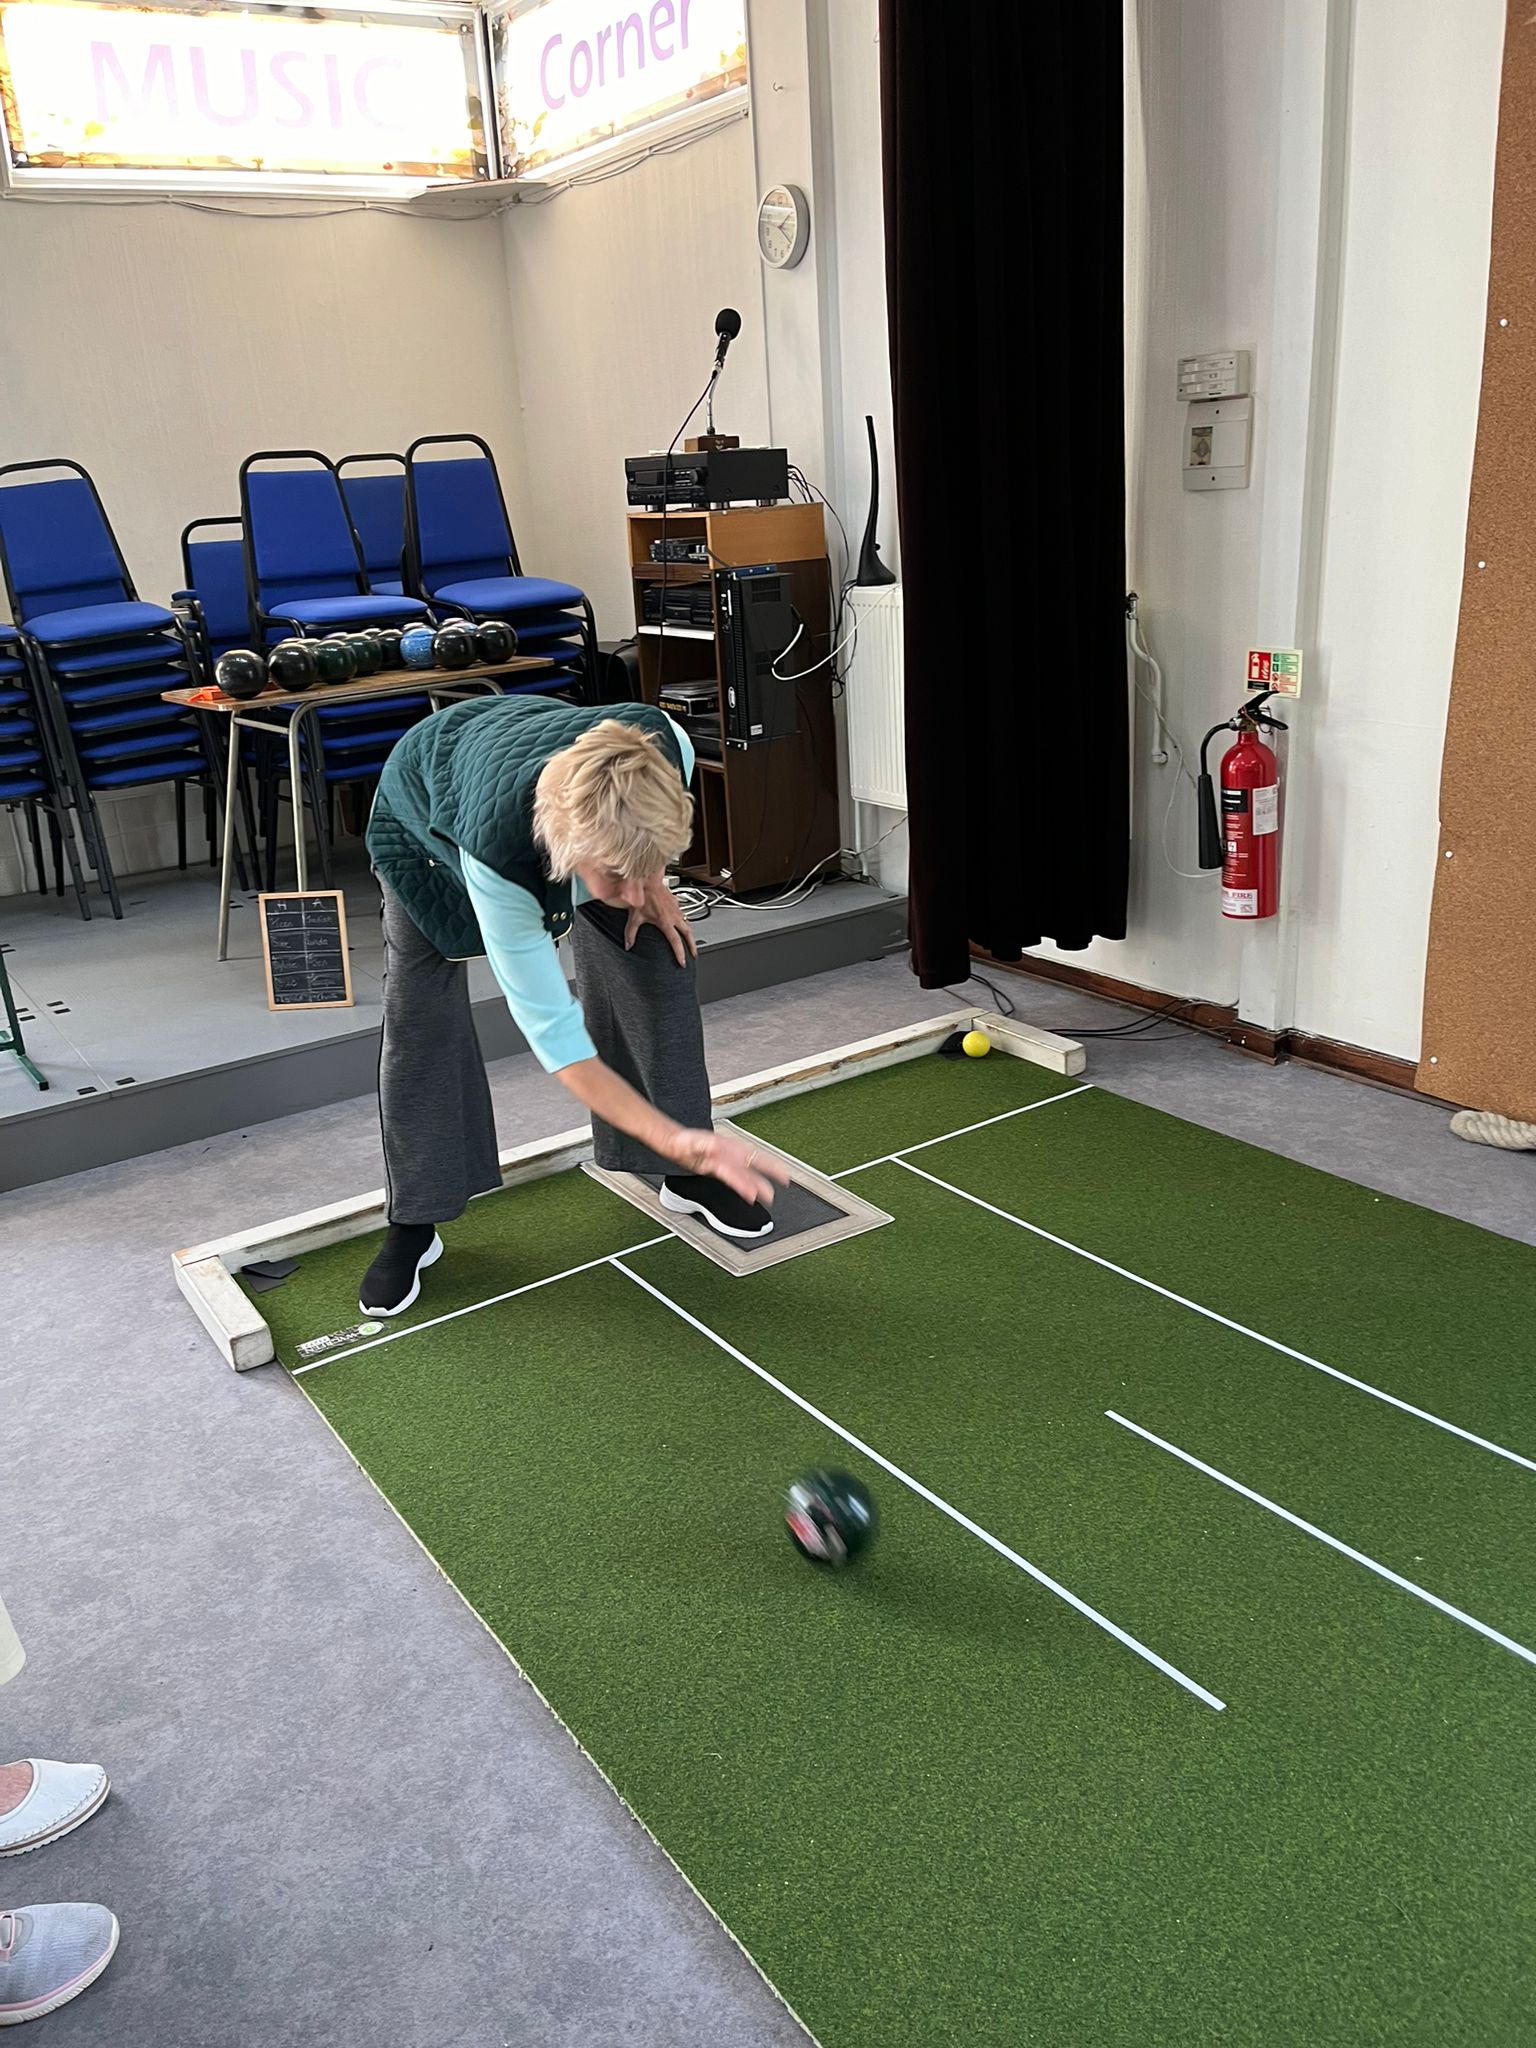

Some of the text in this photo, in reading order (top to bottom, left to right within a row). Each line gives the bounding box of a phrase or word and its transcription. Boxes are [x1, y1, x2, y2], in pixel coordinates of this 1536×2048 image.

[90, 40, 408, 131] MUSIC
[540, 0, 691, 110] Corner
[1232, 892, 1253, 900] FIRE
